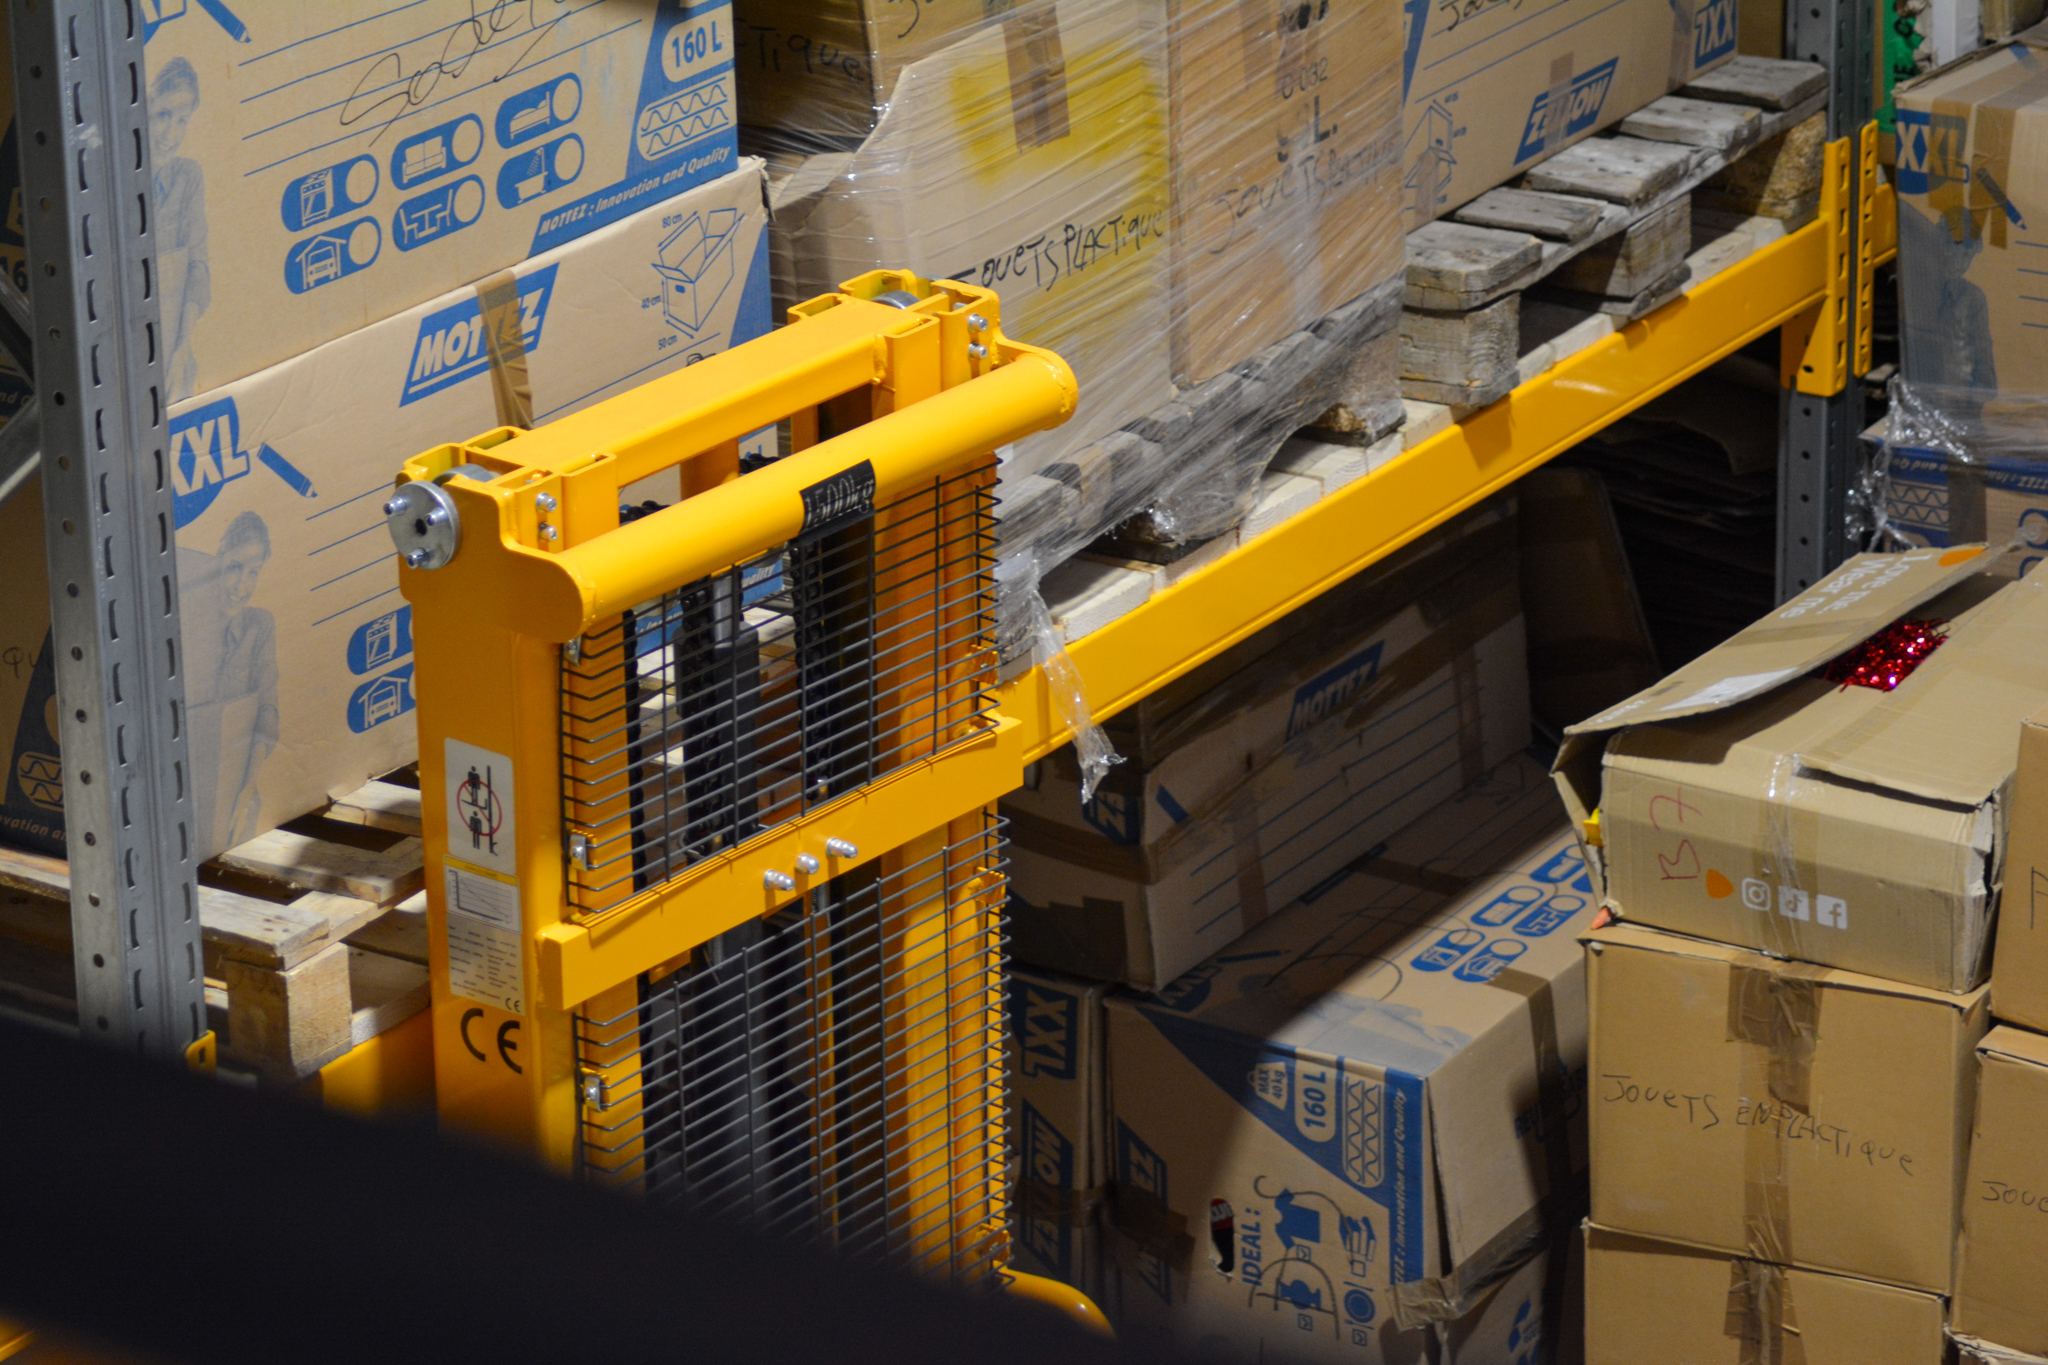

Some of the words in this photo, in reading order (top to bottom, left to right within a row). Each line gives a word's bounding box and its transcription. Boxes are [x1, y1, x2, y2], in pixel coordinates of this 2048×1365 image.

[672, 27, 707, 68] 160
[711, 21, 723, 53] L
[1896, 121, 1969, 180] XXL
[538, 203, 589, 236] MOTTEZ
[595, 176, 661, 213] Innovation
[662, 161, 687, 184] and
[687, 146, 731, 174] Quality
[661, 216, 672, 229] 80
[672, 213, 683, 224] cm
[410, 286, 545, 383] MOTTEZ
[1820, 557, 1894, 594] Wear
[1861, 553, 1932, 589] Love
[1780, 597, 1827, 618] me
[461, 1008, 523, 1075] CE
[1024, 988, 1069, 1075] XXL
[1303, 1071, 1327, 1084] L
[1303, 1087, 1327, 1128] 160
[1241, 1221, 1263, 1286] IDEAL
